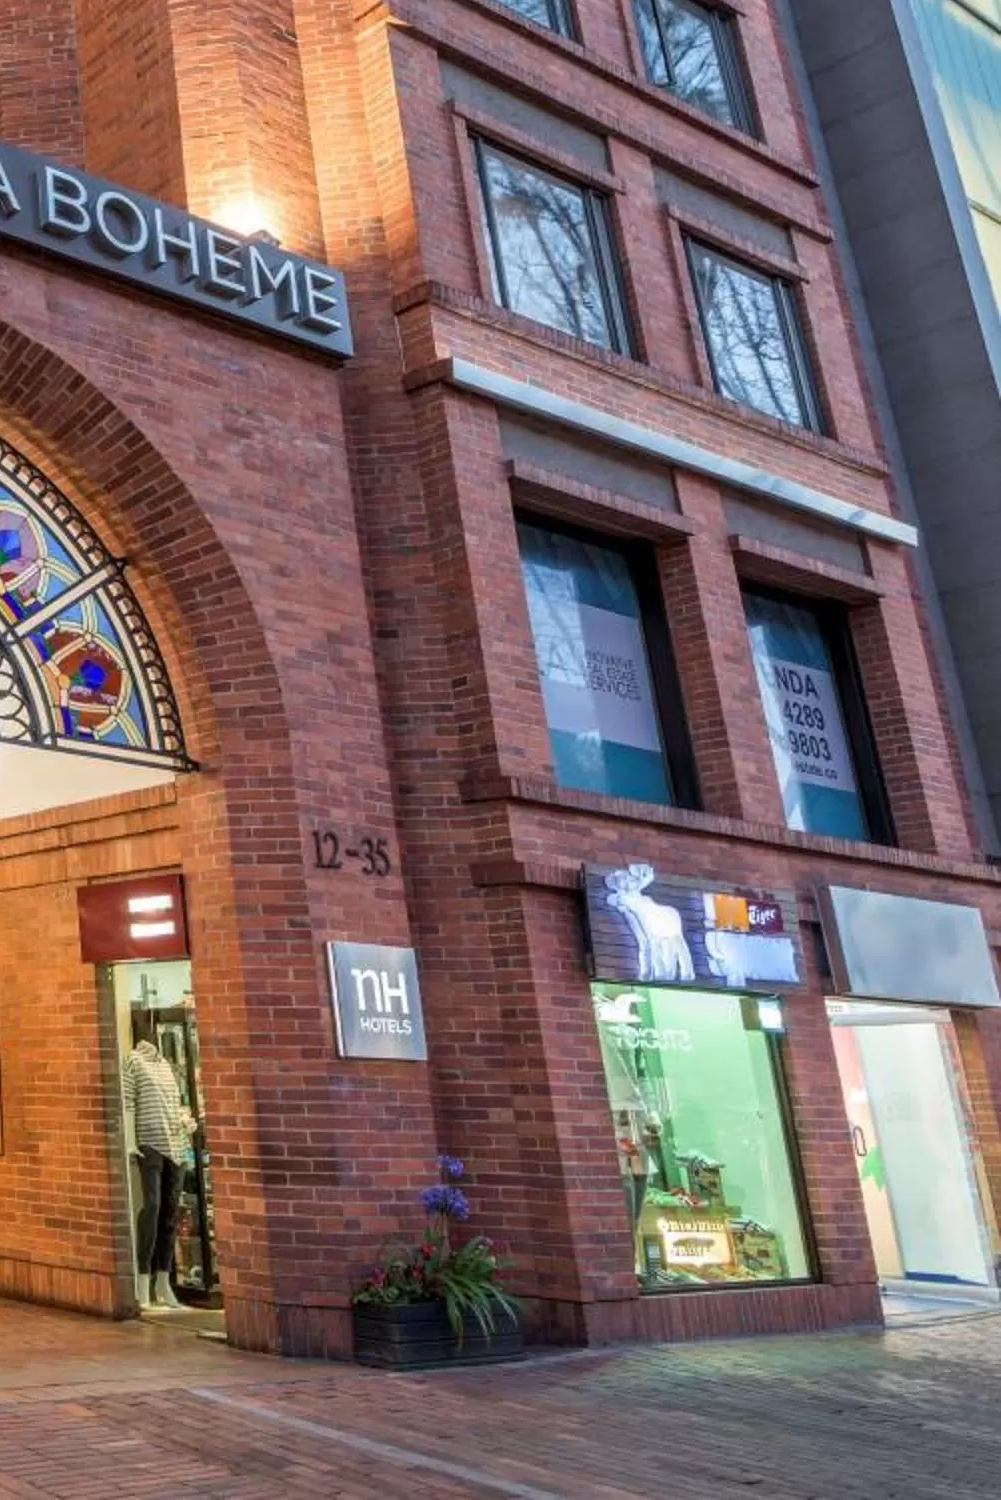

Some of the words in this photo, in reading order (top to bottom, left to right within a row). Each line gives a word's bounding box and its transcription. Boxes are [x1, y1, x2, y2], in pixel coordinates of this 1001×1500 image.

[38, 167, 342, 334] BOHEME
[784, 699, 825, 731] 4289
[788, 729, 832, 761] 9803
[312, 829, 391, 877] 12-35
[360, 1017, 412, 1036] HOTELS
